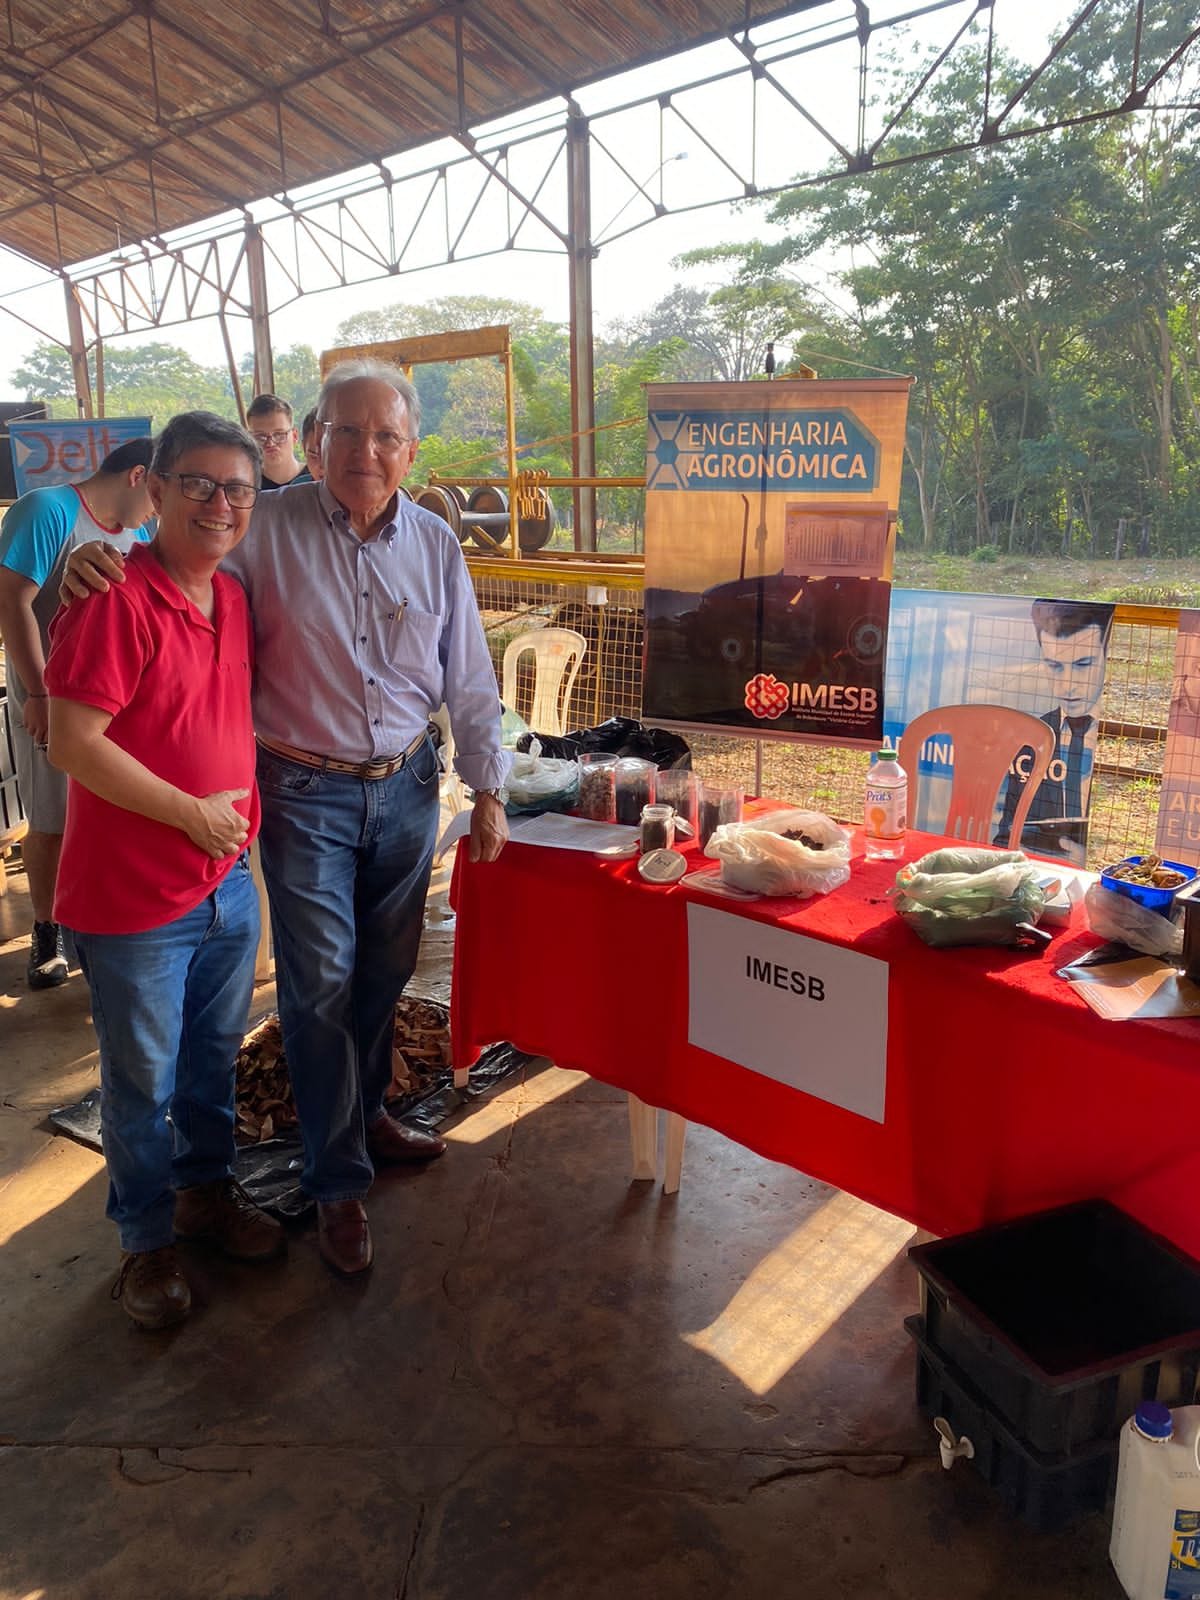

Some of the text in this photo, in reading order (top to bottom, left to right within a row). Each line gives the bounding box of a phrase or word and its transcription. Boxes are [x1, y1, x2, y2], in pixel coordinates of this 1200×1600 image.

[688, 420, 848, 446] ENGENHARIA
[20, 425, 138, 475] Delt
[686, 449, 868, 479] AGRONÔMICA
[791, 682, 878, 712] IMESB
[746, 955, 826, 1002] IMESB
